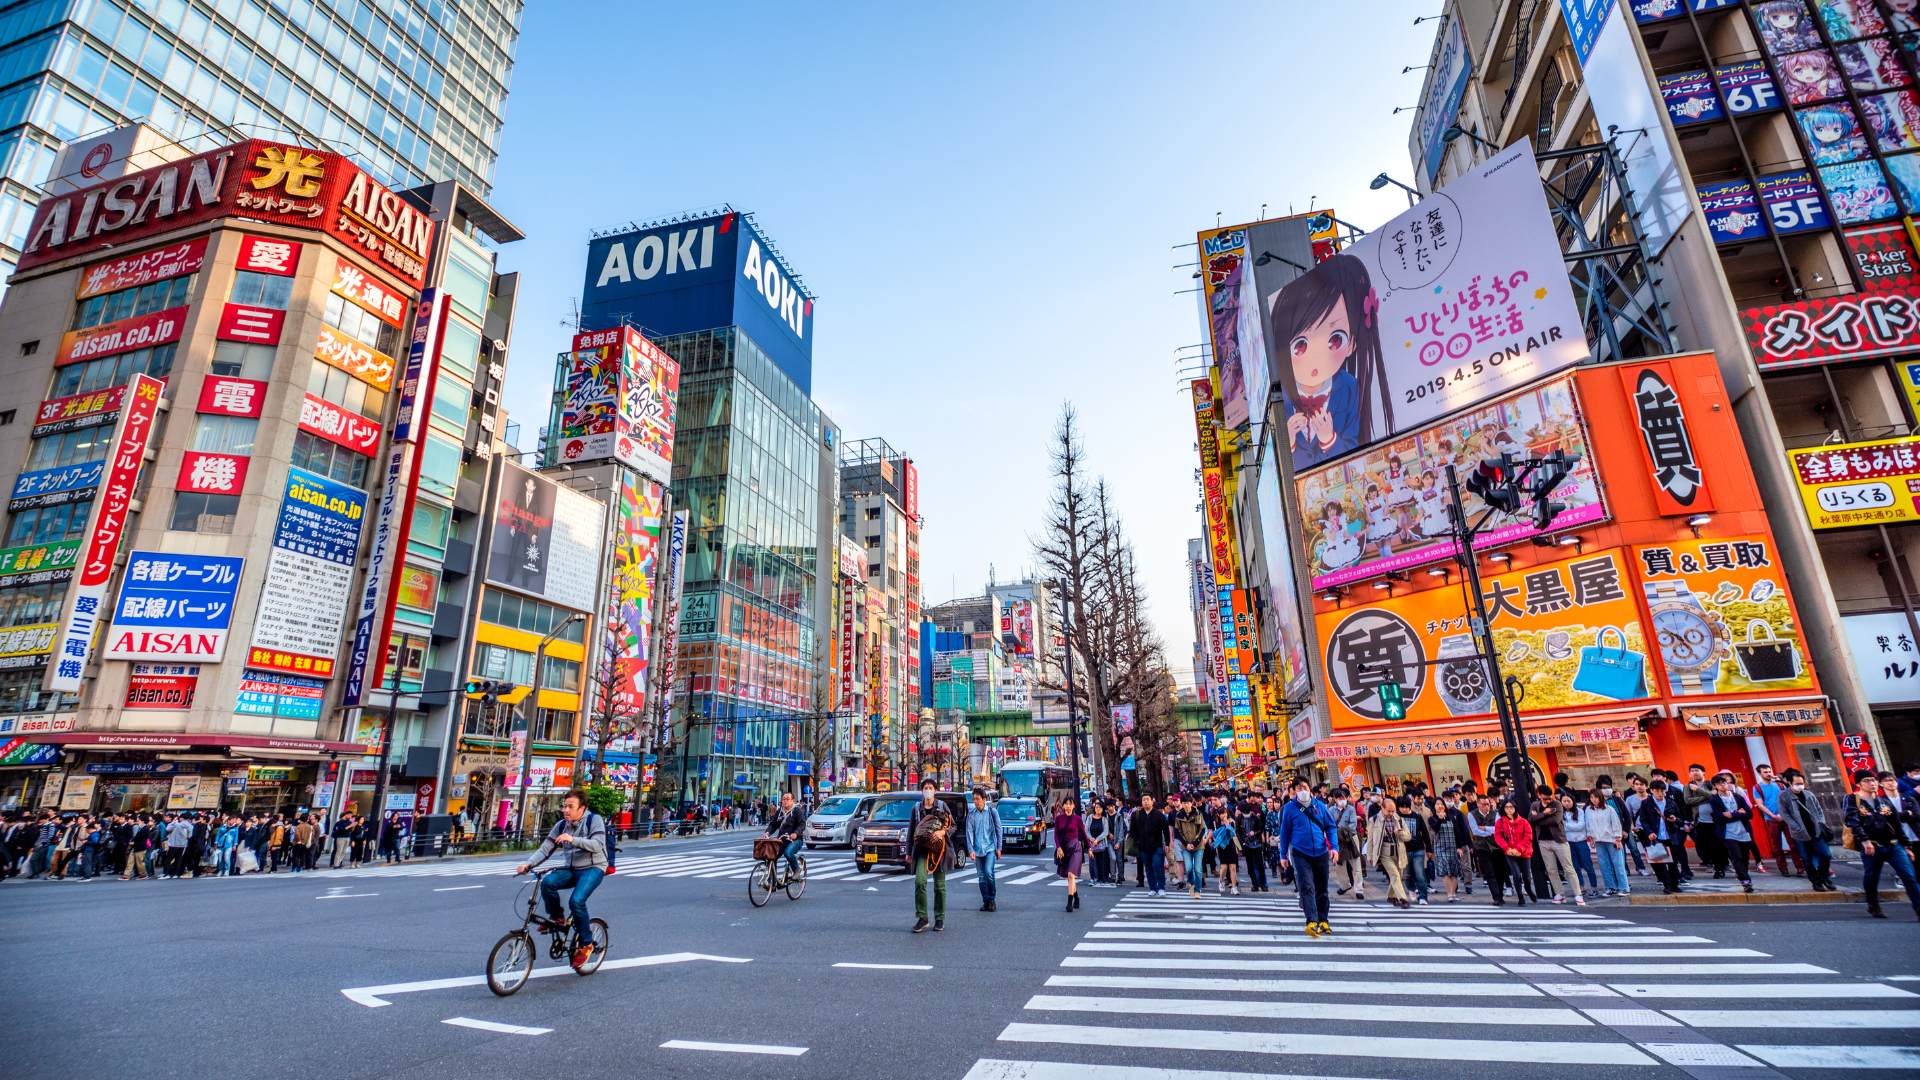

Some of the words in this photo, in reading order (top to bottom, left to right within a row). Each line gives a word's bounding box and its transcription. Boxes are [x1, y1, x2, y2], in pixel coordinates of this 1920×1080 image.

[1662, 82, 1711, 97] アメニティ
[1727, 82, 1776, 112] 6F
[251, 147, 324, 198] 光
[25, 152, 233, 254] AISAN
[237, 192, 324, 218] ネットワーク
[342, 170, 433, 259] AISAN
[1702, 195, 1754, 210] アメニティ
[1770, 197, 1823, 228] 5F
[1426, 208, 1448, 250] 友達に
[248, 240, 292, 271] 愛
[597, 224, 715, 288] AOKI
[1410, 221, 1432, 272] なりたい
[1862, 262, 1912, 278] Stars
[333, 265, 403, 322] 光通信
[744, 239, 805, 339] AOKI
[1405, 270, 1529, 336] ひとりぼっちの
[71, 318, 175, 360] aisan.co.jp
[231, 309, 273, 339] 三
[580, 331, 618, 348] 免税店
[1766, 298, 1911, 355] メイド
[316, 330, 393, 383] ネットワーク
[1406, 361, 1484, 403] 2019.4.5
[1489, 343, 1521, 367] ON
[1526, 326, 1563, 353] AIR
[398, 325, 428, 425] 愛三電機
[40, 403, 61, 420] 3F
[214, 381, 256, 413] 電
[299, 397, 379, 448] 配線パーツ
[17, 477, 37, 493] 2F
[38, 465, 103, 491] ネットワーク
[88, 383, 157, 575] 光・ケーブル・ネットワーク
[190, 456, 237, 490] 機
[1805, 448, 1920, 479] 全身もみほ
[289, 484, 362, 520] aisan.co.jp
[1824, 487, 1887, 507] りらくる
[1820, 509, 1906, 525] 秋葉原中央通り店
[672, 515, 684, 557] AKKY
[14, 545, 78, 571] 電線・セッ
[131, 559, 236, 585] 各種ケーブル
[1642, 541, 1771, 577] 質&買取
[1204, 566, 1217, 597] AKKY
[1484, 554, 1626, 624] 大黒屋
[121, 596, 227, 621] 配線パーツ
[686, 611, 709, 619] OPEN
[58, 596, 98, 679] 愛三電機
[112, 632, 219, 655] AISAN
[1209, 607, 1221, 653] Tax-free
[1877, 633, 1913, 654] 喫茶
[347, 620, 370, 698] AISAN
[1214, 656, 1225, 683] Shop
[128, 686, 194, 706] aisan.co.jp
[1231, 690, 1248, 698] DVD
[1712, 707, 1824, 727] 1階にて高価買取中
[1579, 726, 1637, 742] 無料査定
[1843, 735, 1863, 750] 4F
[556, 766, 571, 777] au
